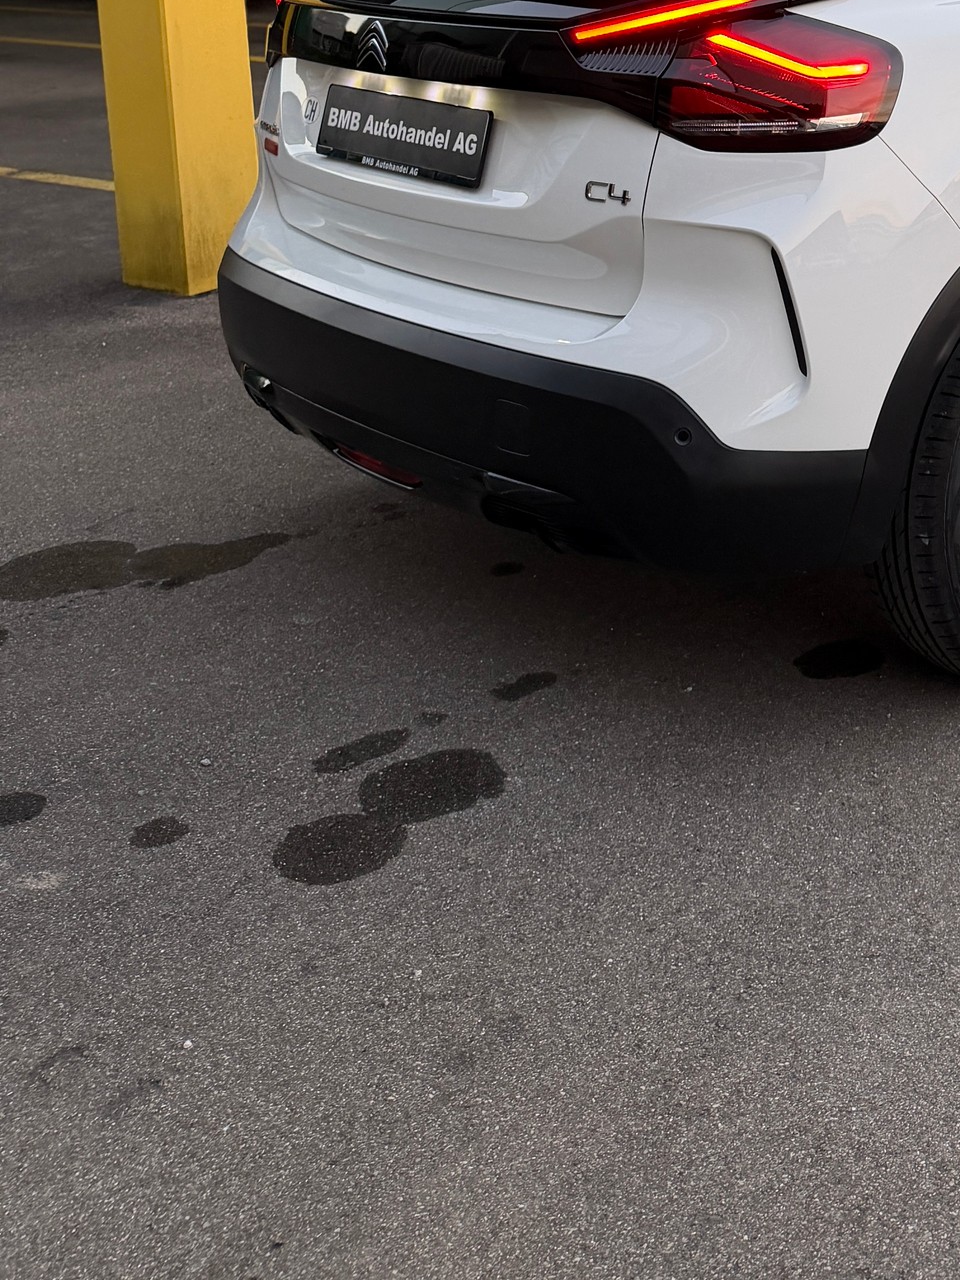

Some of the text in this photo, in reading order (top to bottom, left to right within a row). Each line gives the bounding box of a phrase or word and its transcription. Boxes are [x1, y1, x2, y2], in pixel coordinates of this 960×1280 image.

[303, 98, 319, 123] CH
[327, 107, 478, 156] BMB Autohandel AG
[361, 156, 419, 177] BMB Autohandel AG
[584, 180, 632, 206] C4
